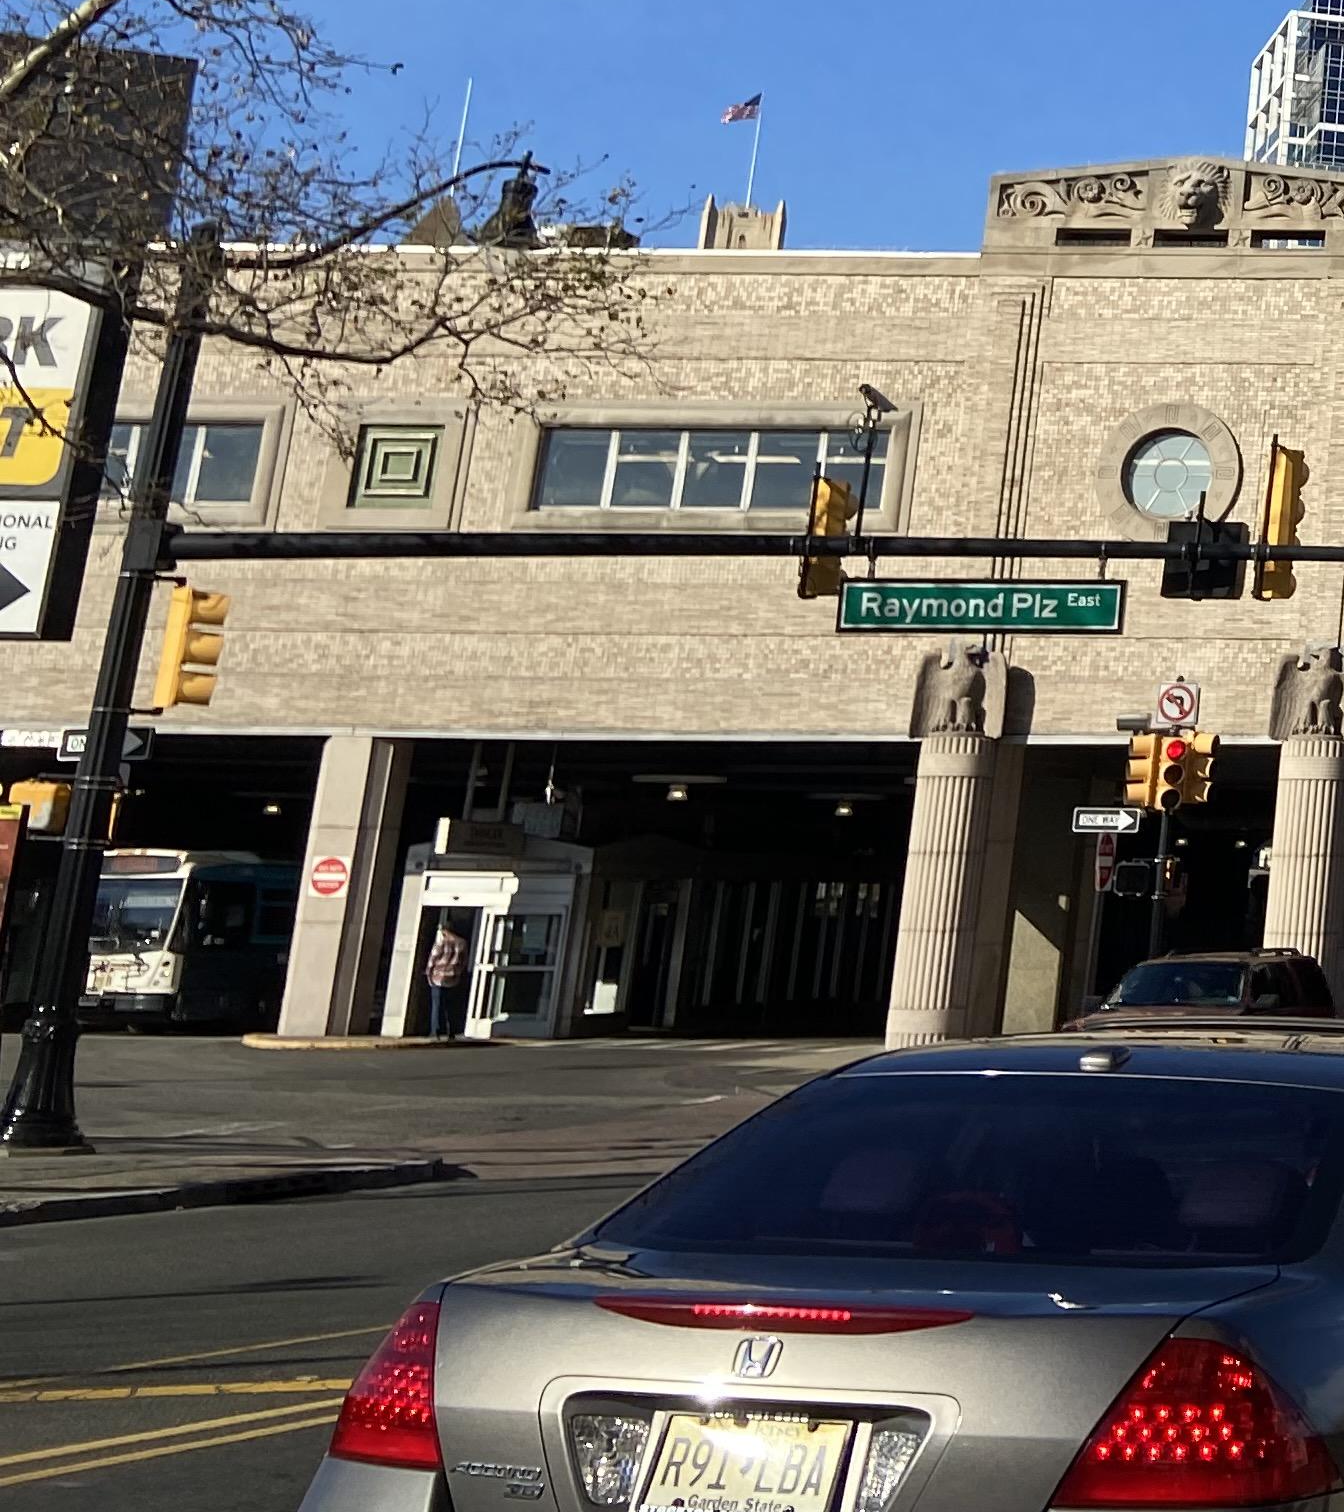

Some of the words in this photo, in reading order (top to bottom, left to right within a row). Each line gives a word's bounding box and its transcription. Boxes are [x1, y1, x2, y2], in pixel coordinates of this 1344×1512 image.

[860, 591, 1004, 623] Raymond
[1011, 592, 1058, 618] Plz
[1067, 592, 1101, 607] East
